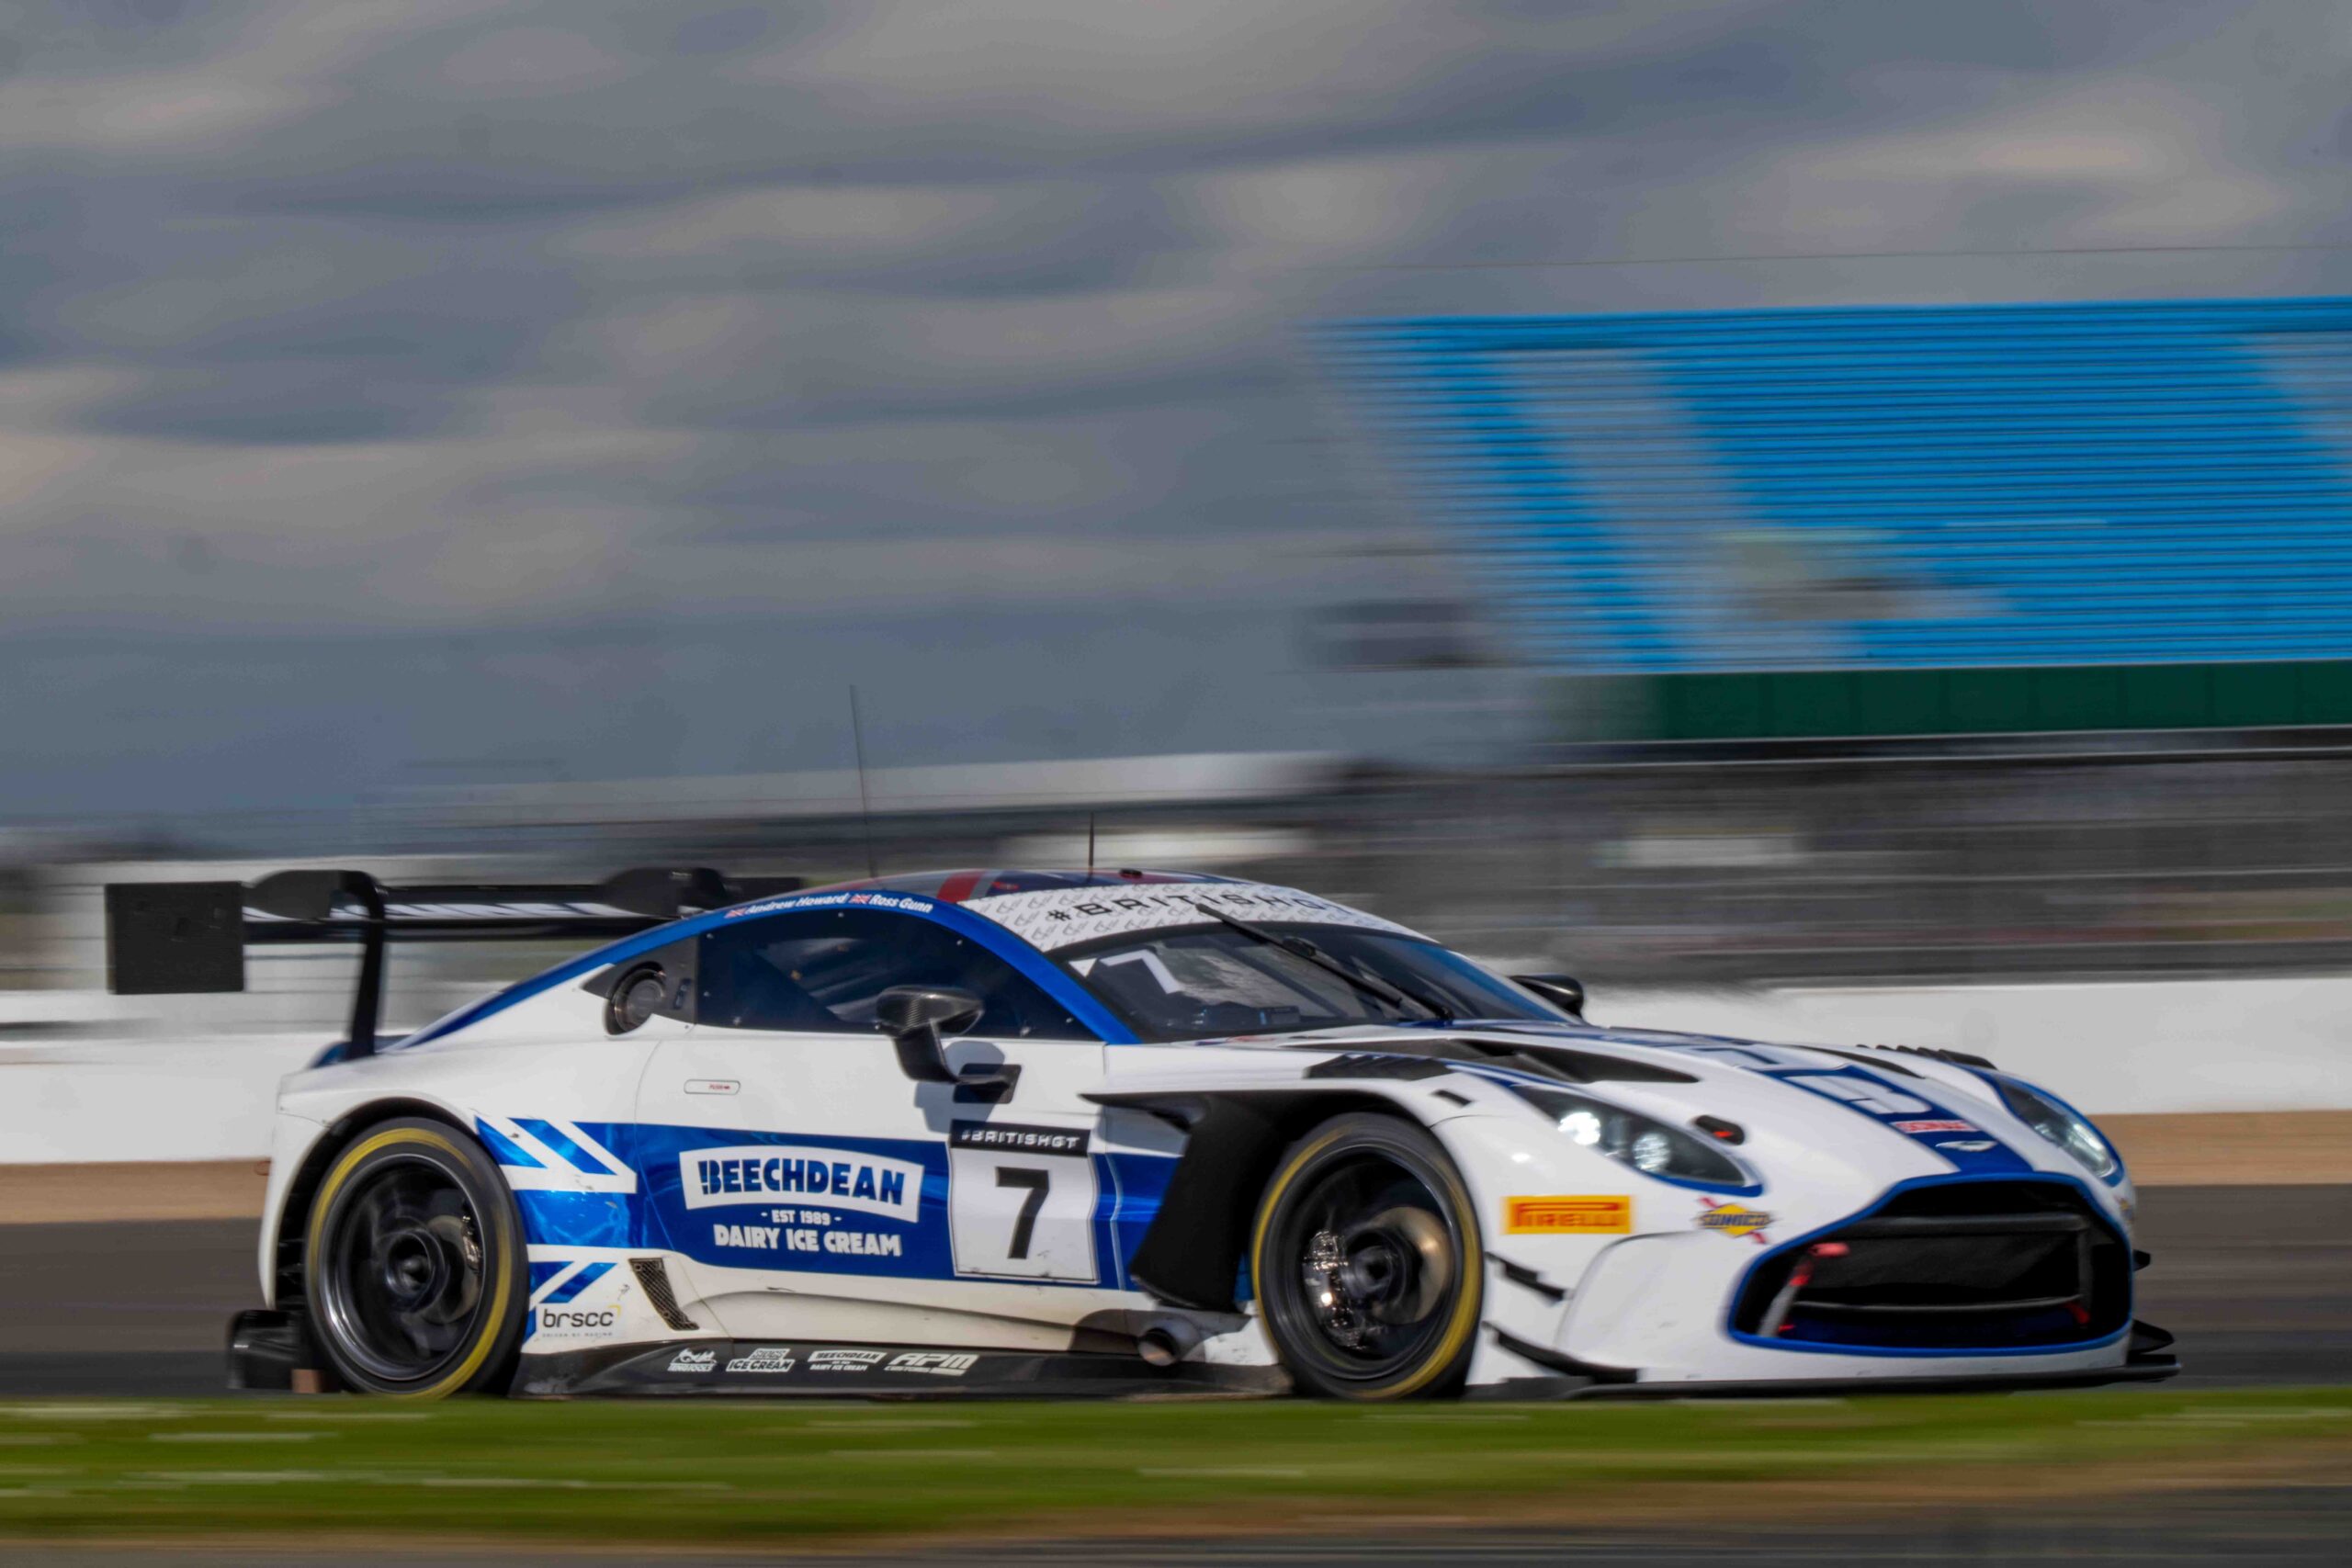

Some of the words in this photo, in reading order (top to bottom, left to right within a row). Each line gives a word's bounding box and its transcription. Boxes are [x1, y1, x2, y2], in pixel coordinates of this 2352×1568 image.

[745, 899, 795, 914] Andrew
[796, 893, 850, 908] Howard
[870, 894, 898, 908] Ross
[899, 897, 933, 913] Gunn
[961, 1130, 1080, 1149] #BRITISHGT
[698, 1157, 905, 1206] BEECHDEAN
[771, 1210, 796, 1224] EST
[995, 1167, 1050, 1259] 7
[713, 1224, 781, 1249] DAIRY
[786, 1228, 820, 1252] ICE
[823, 1231, 902, 1257] CREAM
[543, 1308, 614, 1328] brscc
[729, 1359, 749, 1370] ICE
[750, 1359, 792, 1370] CREAM
